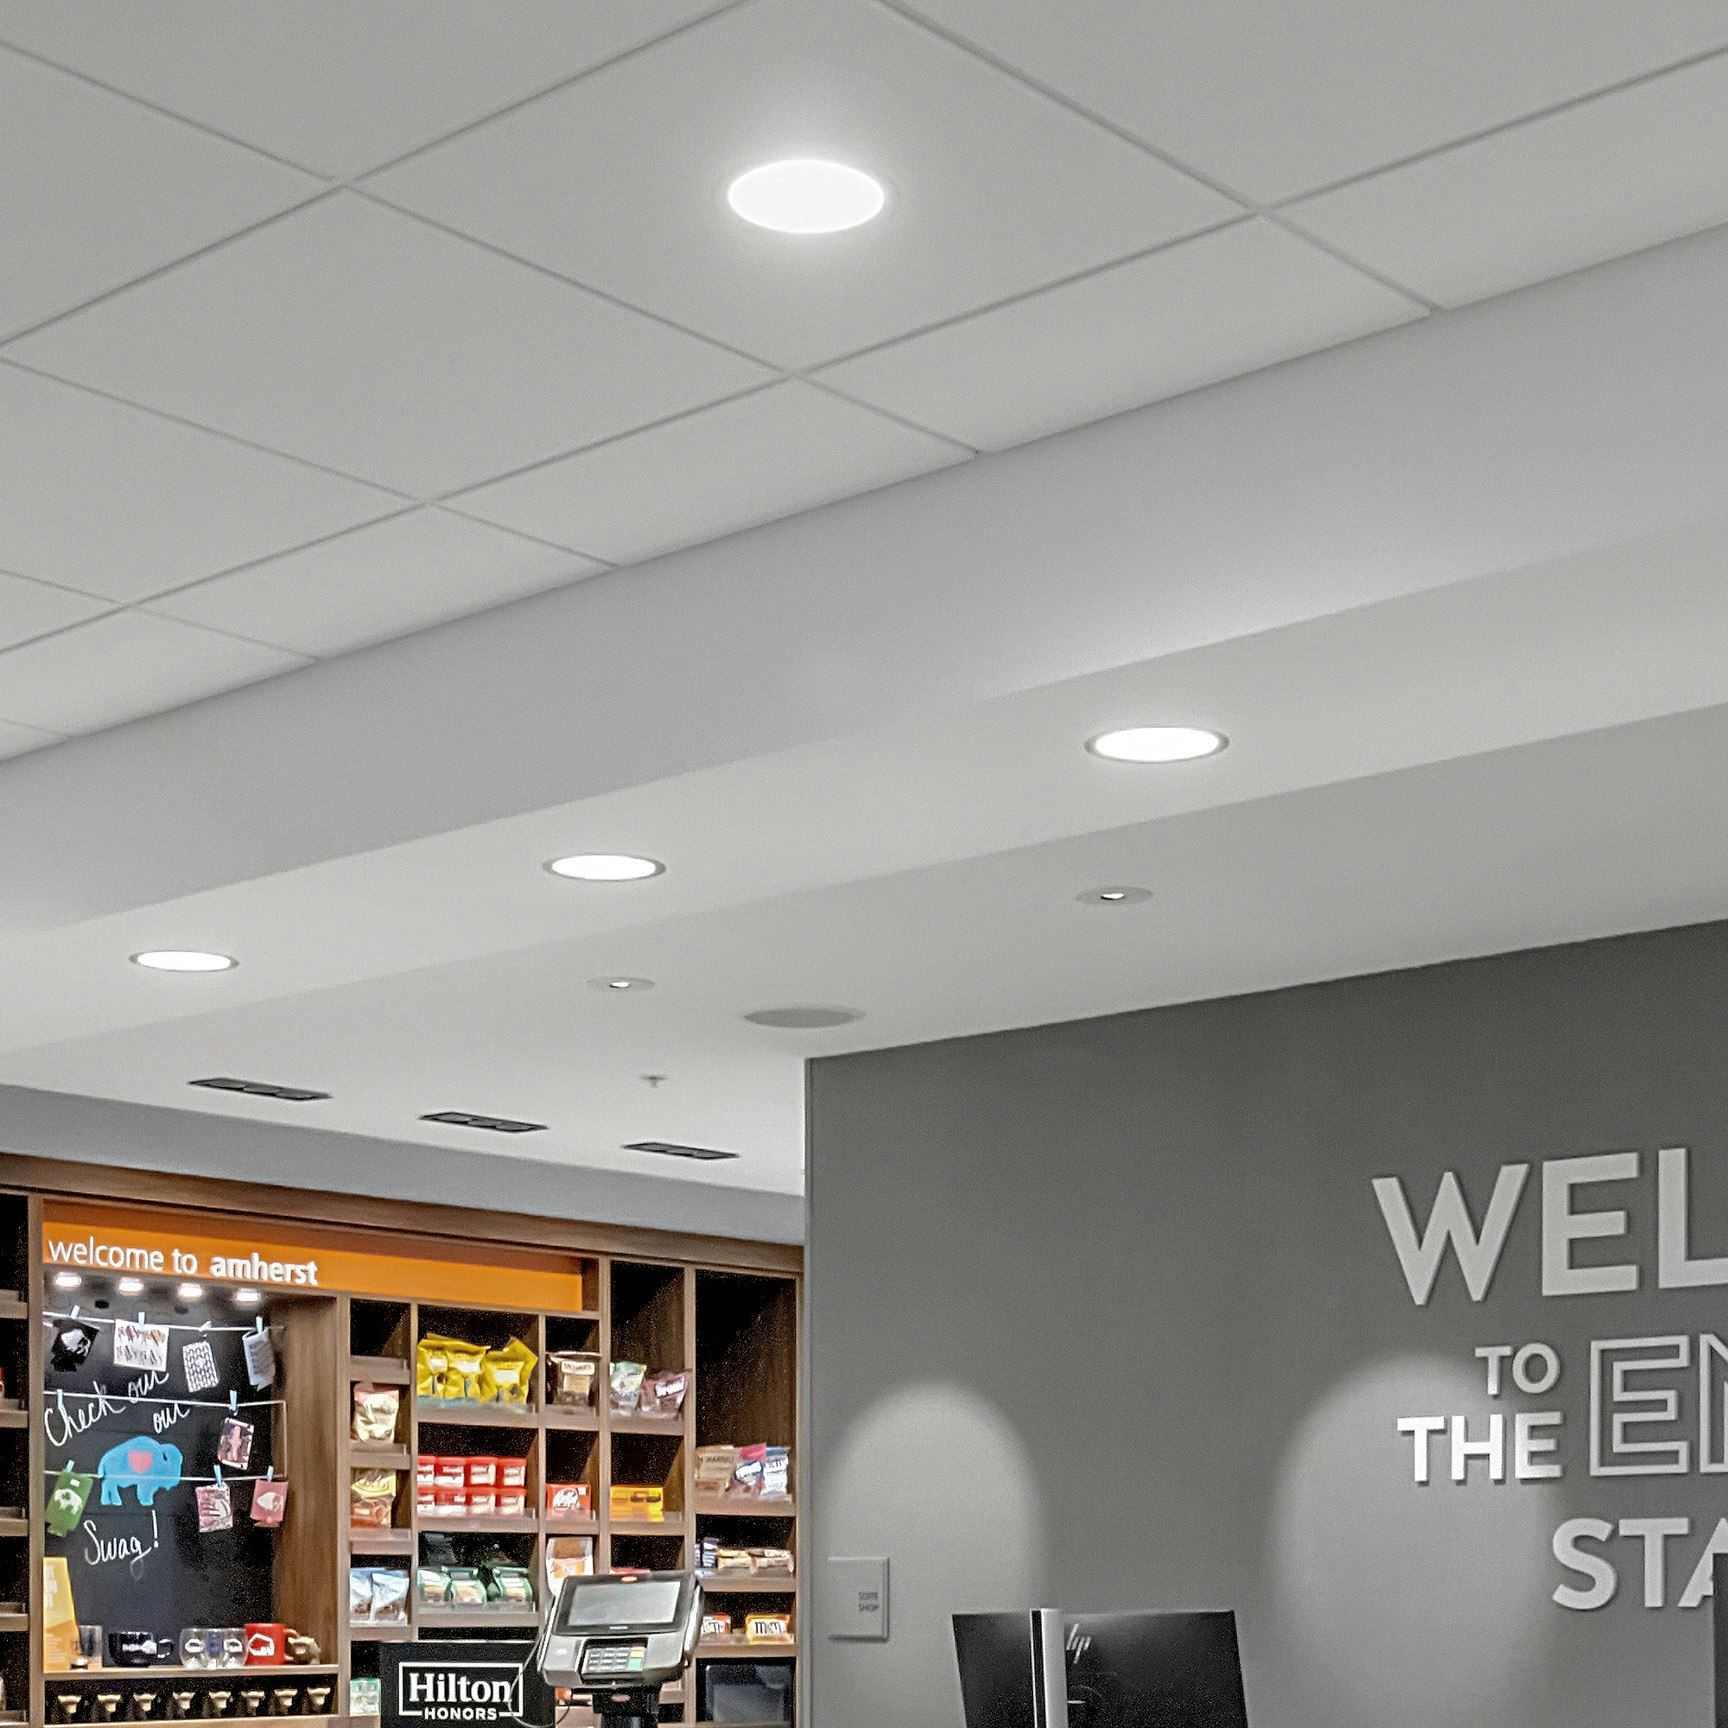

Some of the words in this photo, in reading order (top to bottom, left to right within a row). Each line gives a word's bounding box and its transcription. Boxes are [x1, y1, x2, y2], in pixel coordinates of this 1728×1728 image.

[48, 1236, 164, 1271] welcome
[173, 1248, 198, 1274] to
[209, 1252, 319, 1285] amherst
[1475, 1344, 1560, 1395] TO
[44, 1381, 126, 1446] Check
[153, 1402, 190, 1433] our
[1397, 1411, 1562, 1482] THE
[409, 1673, 513, 1703] Hilton
[424, 1707, 498, 1721] HONORS
